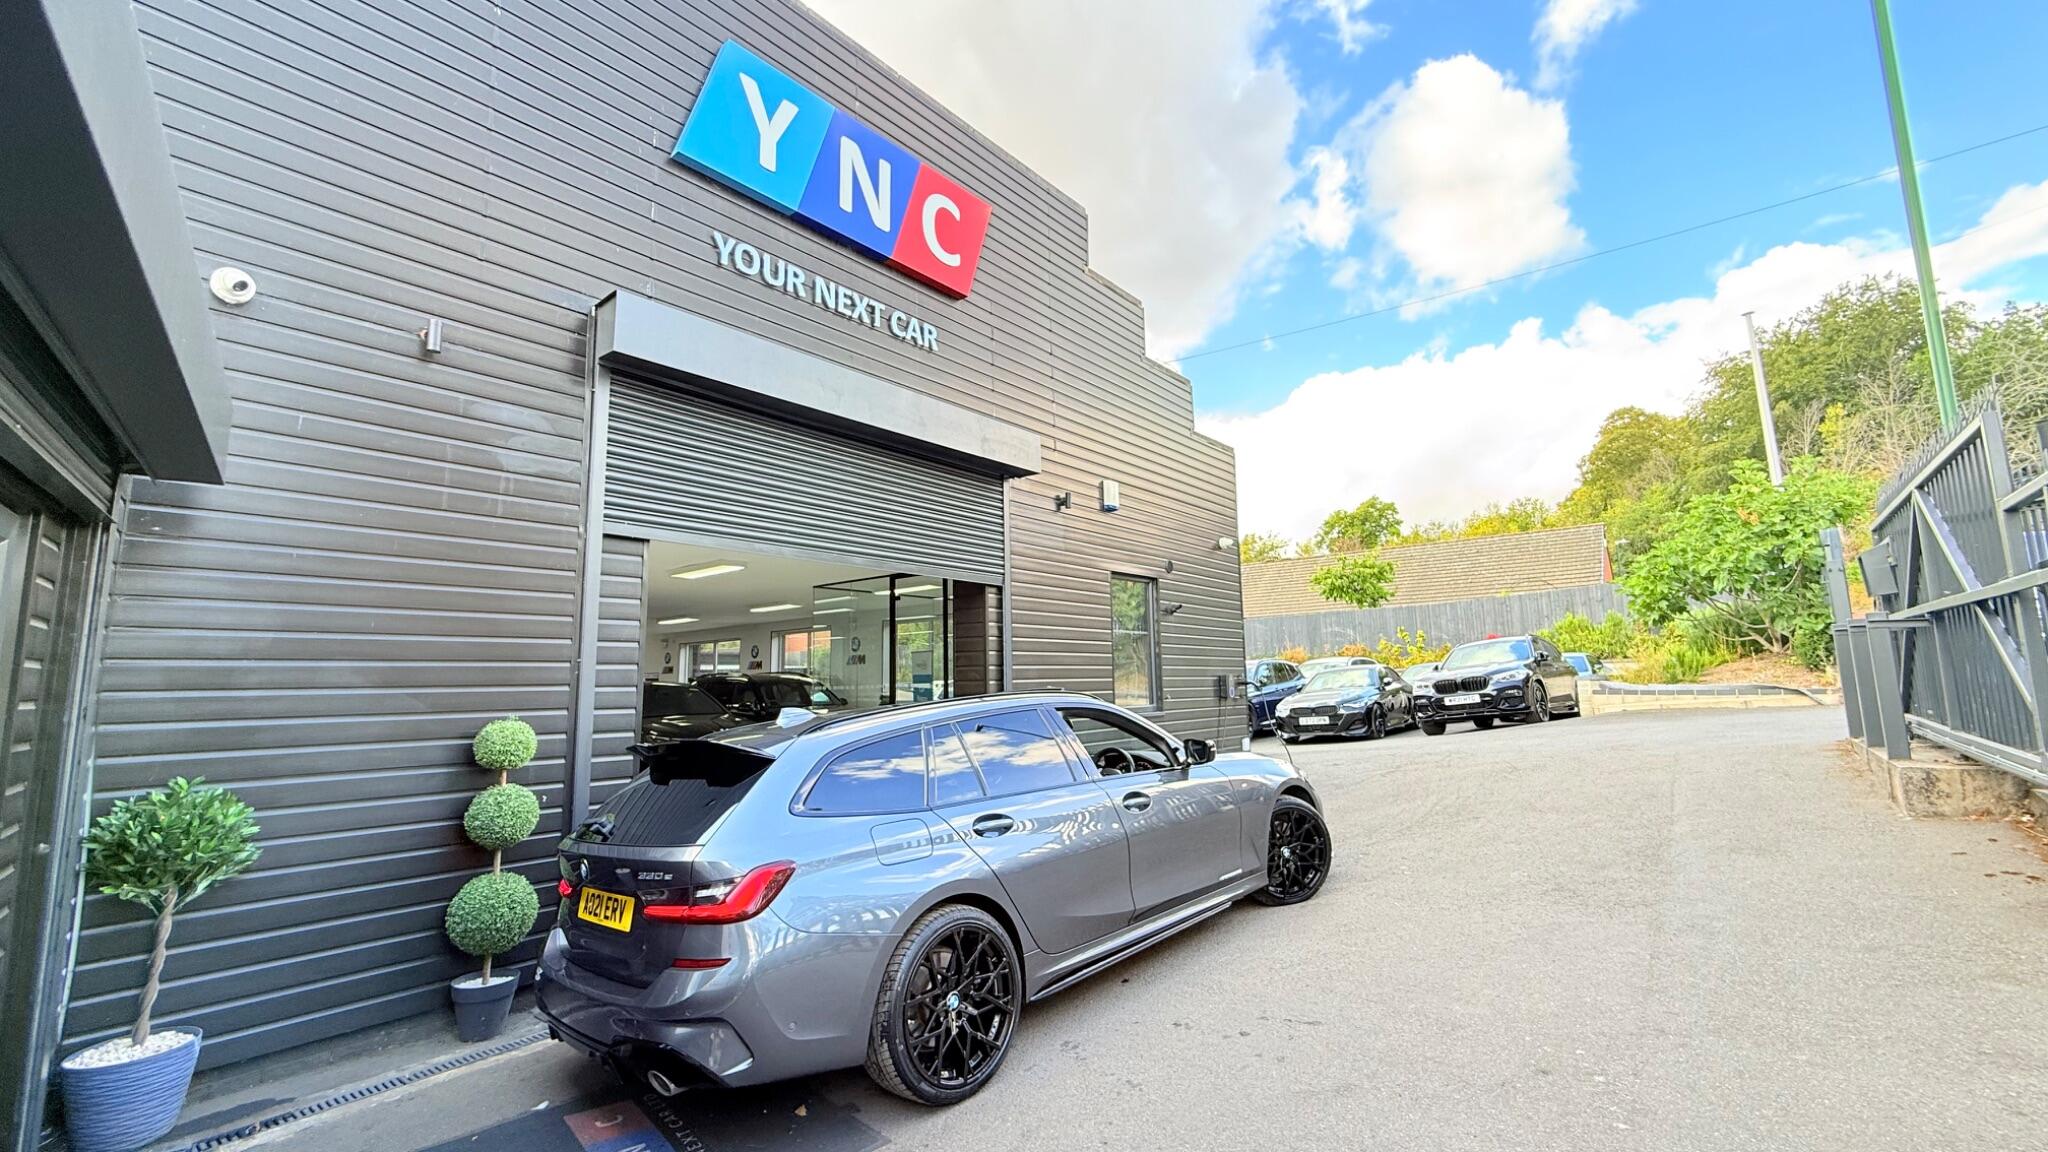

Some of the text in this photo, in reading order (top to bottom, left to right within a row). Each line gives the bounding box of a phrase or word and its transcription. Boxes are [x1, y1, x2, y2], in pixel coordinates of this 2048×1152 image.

[739, 72, 961, 267] YNC
[712, 230, 939, 352] YOUR NEXT CAR
[603, 896, 627, 924] ERV
